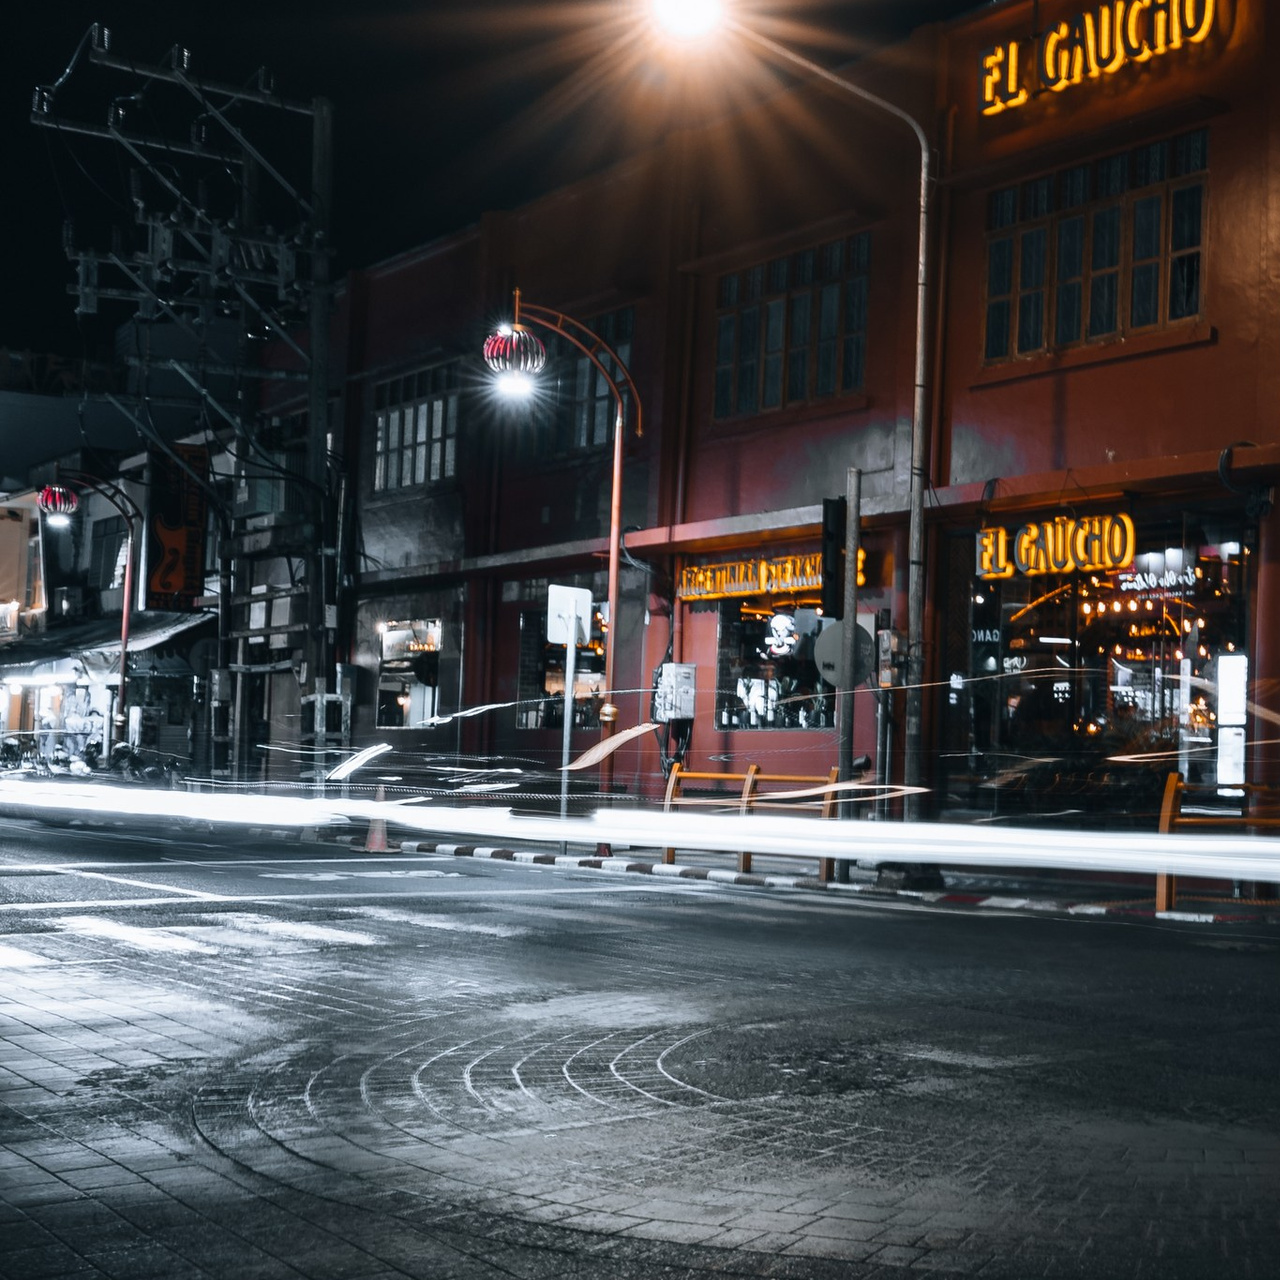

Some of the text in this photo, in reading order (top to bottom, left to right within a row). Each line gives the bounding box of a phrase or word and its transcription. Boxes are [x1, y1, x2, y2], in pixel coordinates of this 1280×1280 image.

[978, 40, 1028, 115] EL
[975, 512, 1136, 580] EL GAUCHO
